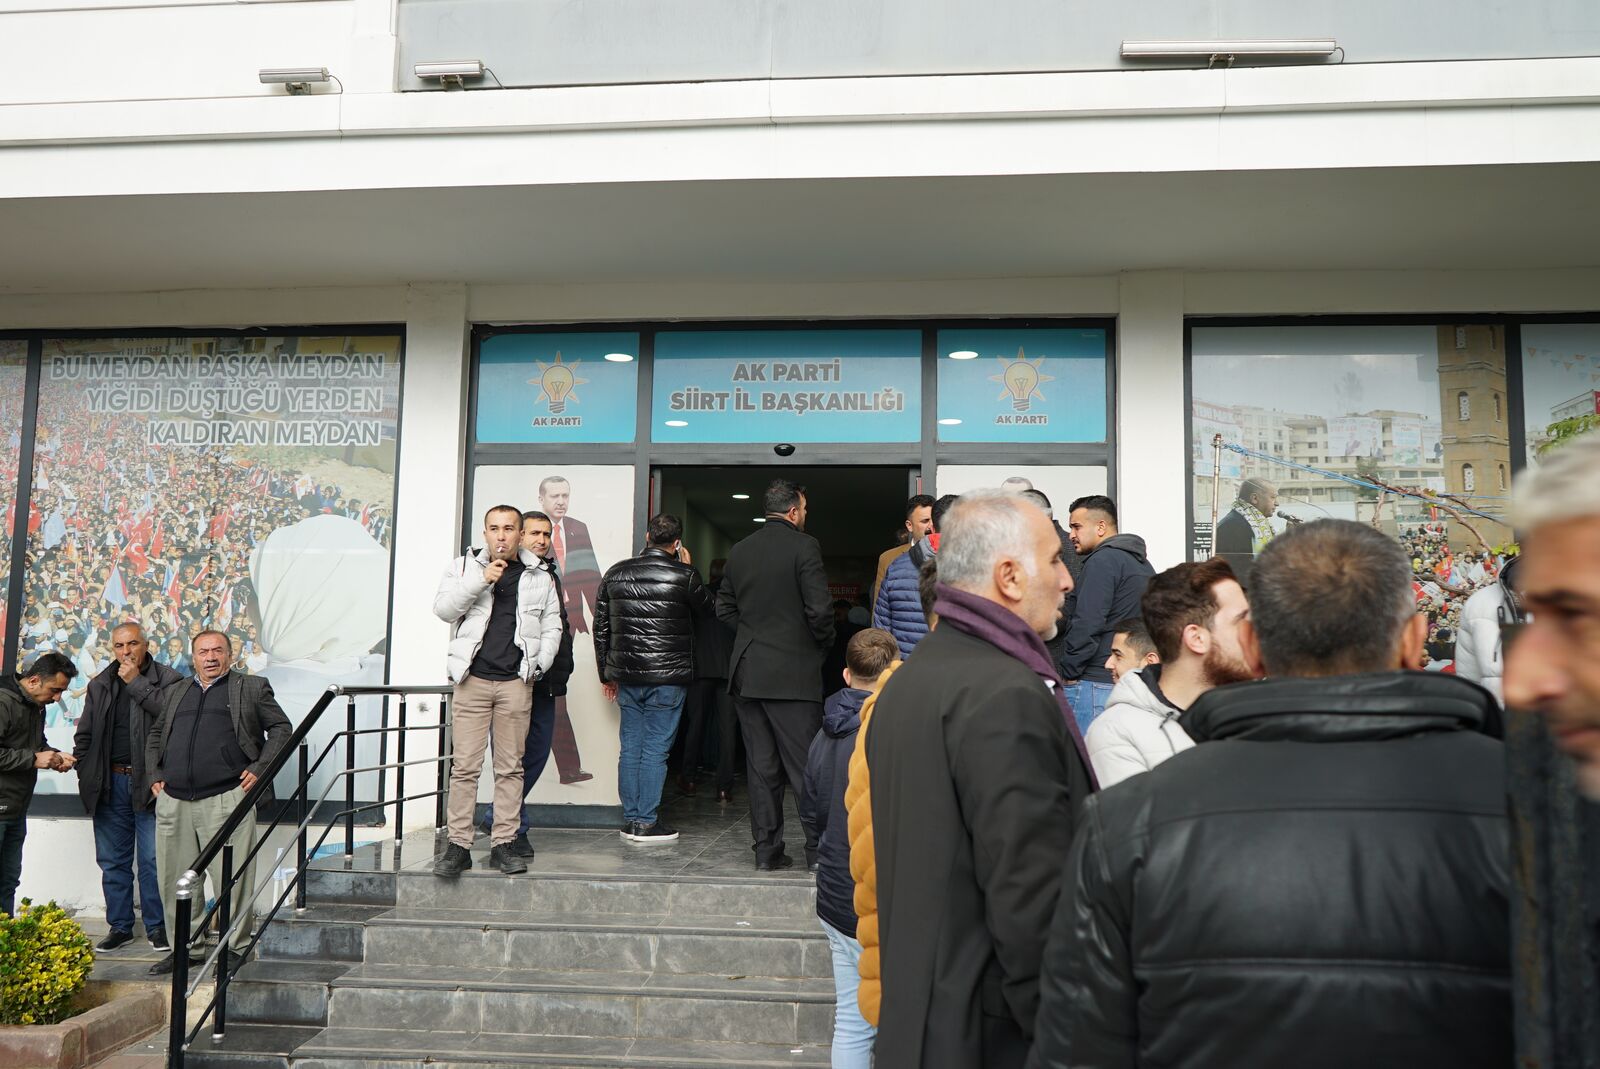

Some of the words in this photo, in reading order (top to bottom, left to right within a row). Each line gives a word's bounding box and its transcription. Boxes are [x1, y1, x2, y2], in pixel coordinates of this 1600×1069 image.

[51, 355, 82, 379] BU
[87, 355, 190, 379] MEYDAN
[197, 354, 273, 384] BAŞKA
[279, 353, 384, 378] MEYDAN
[732, 363, 767, 382] AK
[772, 358, 840, 382] PARTİ
[86, 381, 161, 412] YİĞİDİ
[167, 381, 280, 418] DÜŞTÜĞÜ
[286, 387, 383, 412] YERDEN
[670, 387, 730, 411] SİİRT
[734, 387, 756, 411] İL
[761, 388, 903, 415] BAŞKANLIĞI
[532, 417, 548, 426] AK
[995, 415, 1012, 424] AK
[149, 421, 268, 446] KALDIRAN
[274, 421, 380, 446] MEYDAN
